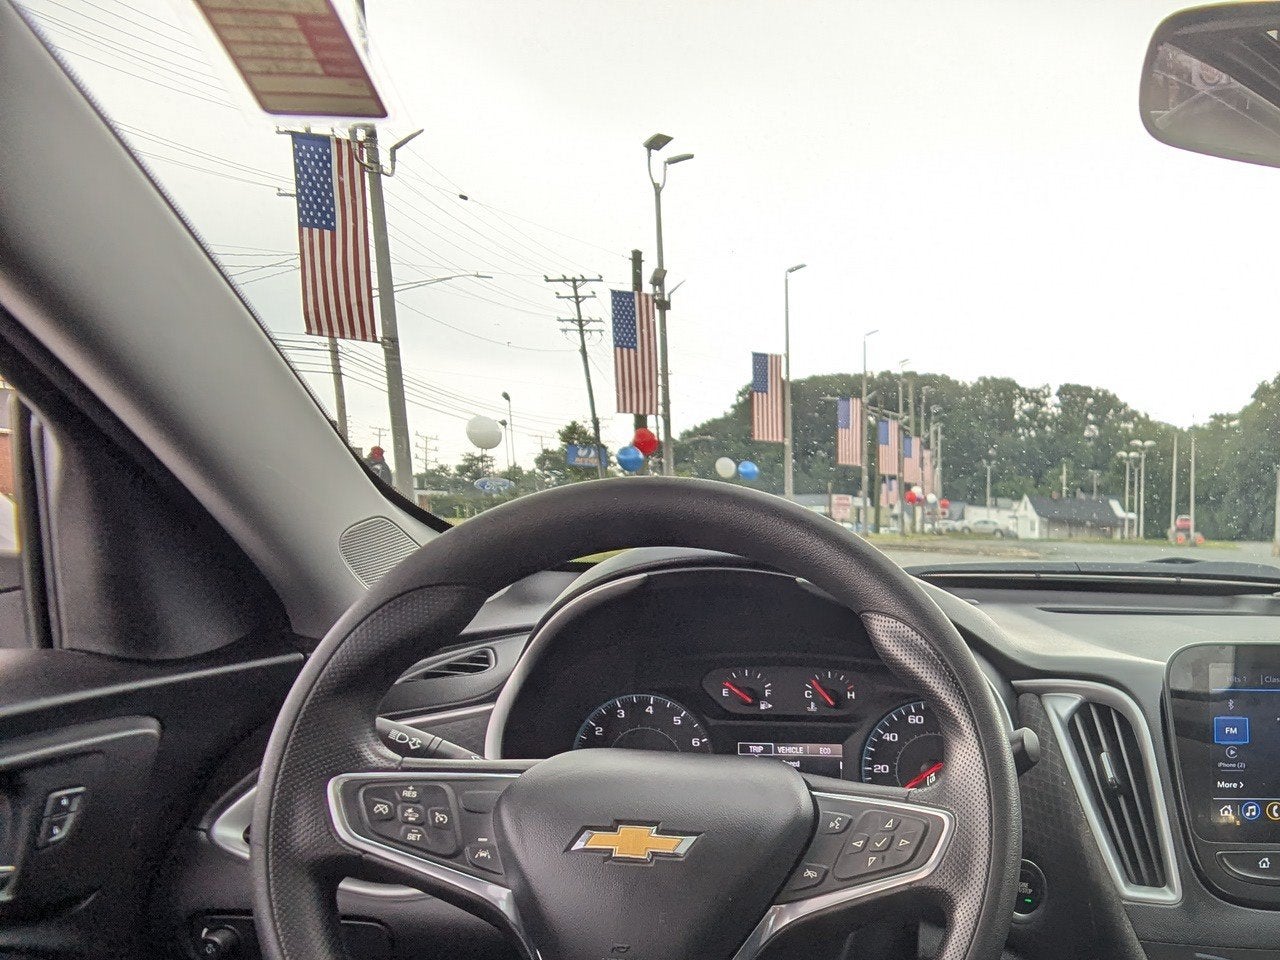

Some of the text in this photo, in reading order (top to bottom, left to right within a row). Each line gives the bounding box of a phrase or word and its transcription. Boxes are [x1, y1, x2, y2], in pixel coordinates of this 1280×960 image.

[722, 688, 730, 697] E
[764, 689, 772, 698] F
[804, 690, 813, 699] C
[847, 691, 856, 700] H
[616, 709, 625, 719] 3
[645, 705, 654, 715] 4
[673, 716, 682, 725] 5
[907, 715, 924, 724] 60
[594, 726, 604, 736] 2
[1225, 727, 1238, 735] FM
[882, 732, 899, 742] 40
[691, 737, 701, 747] 6
[748, 745, 764, 753] TRIP
[777, 746, 804, 754] VEHICLE
[819, 747, 832, 755] ECO
[873, 764, 890, 774] 20
[1217, 781, 1238, 789] More
[402, 789, 418, 798] RES
[406, 832, 422, 841] SET
